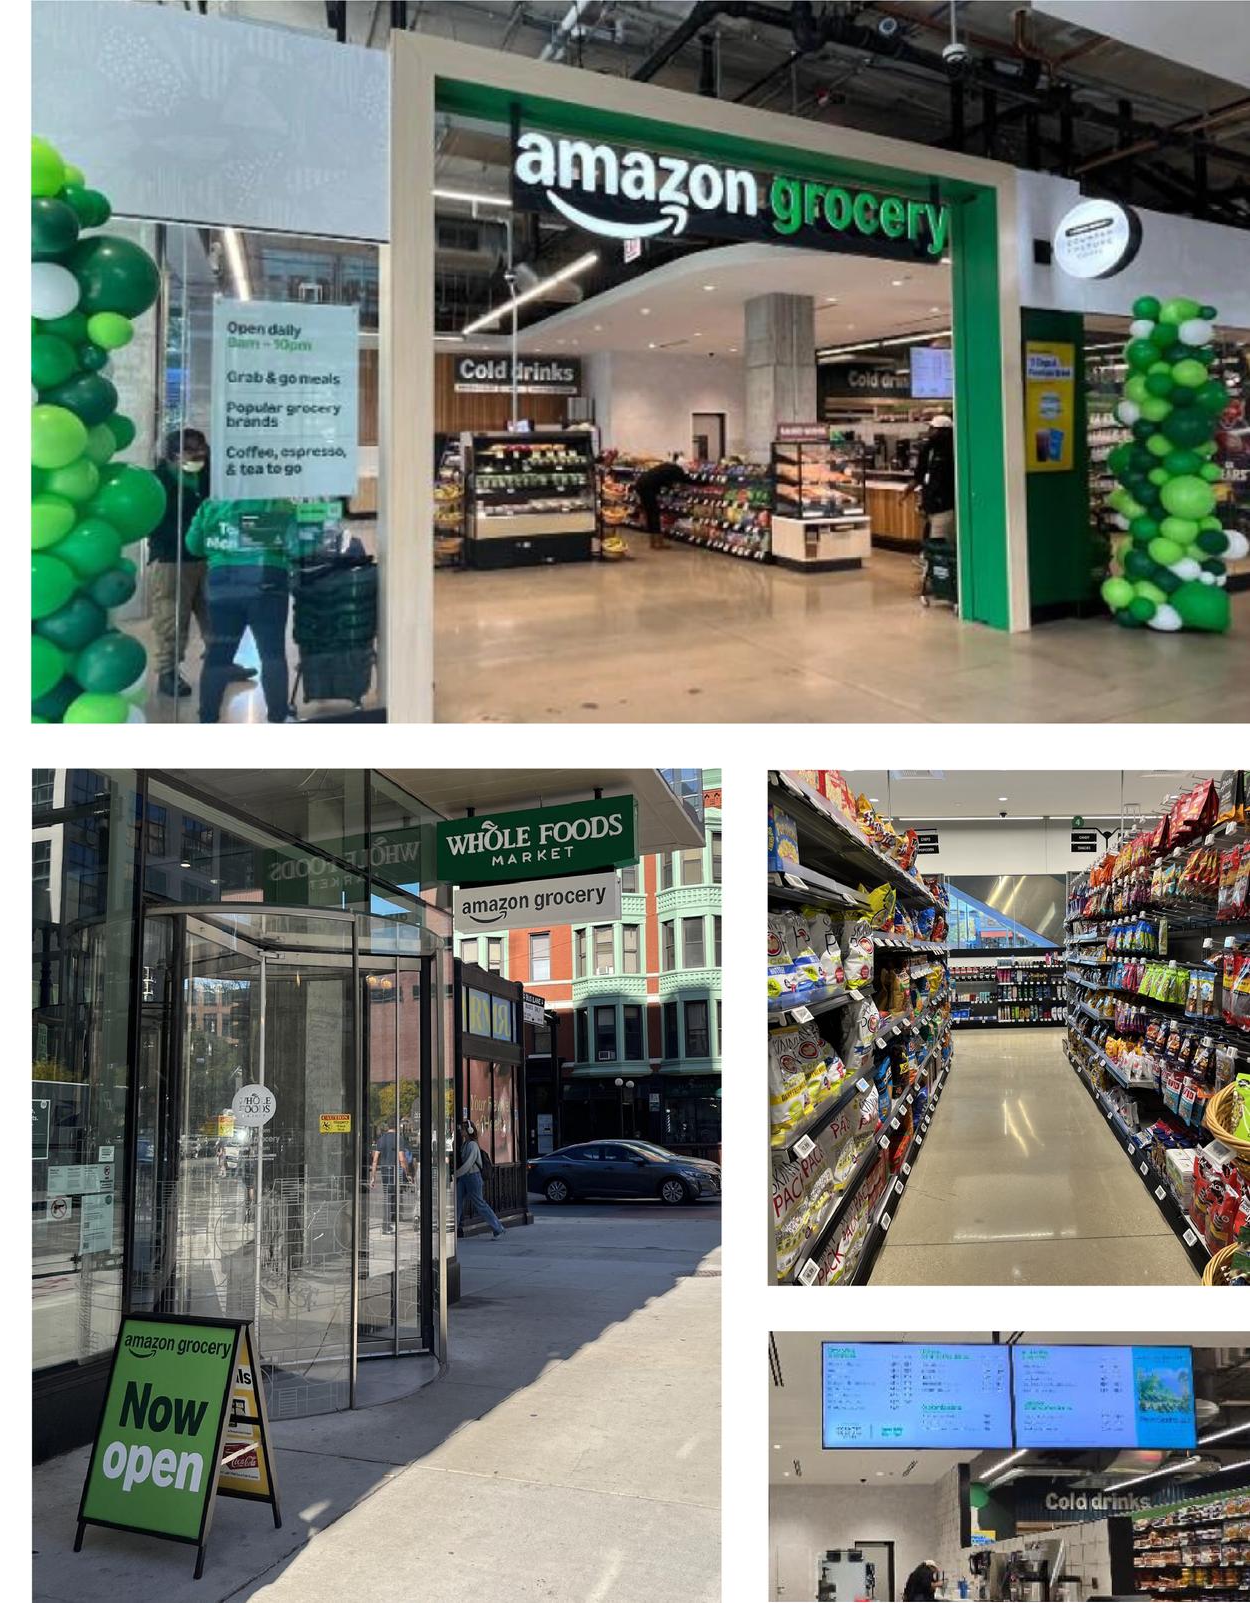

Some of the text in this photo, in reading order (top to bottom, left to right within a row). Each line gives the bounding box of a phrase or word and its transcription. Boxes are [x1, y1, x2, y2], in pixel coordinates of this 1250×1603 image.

[515, 132, 950, 255] amazon grocery
[227, 321, 302, 340] Open daily
[273, 339, 313, 352] 10pm
[226, 370, 341, 388] Grab & go meals
[460, 359, 507, 380] Cold
[848, 371, 878, 387] Cold
[226, 401, 342, 417] Popular grocery
[226, 416, 279, 428] brands
[226, 446, 347, 460] Coffee, espresso,
[226, 463, 302, 476] & tea to go
[446, 813, 623, 856] WHOLE FOODS
[491, 846, 574, 866] MARKET
[462, 887, 607, 915] amazon grocery
[125, 1333, 232, 1359] amazon grocery
[118, 1380, 209, 1437] Now
[102, 1440, 204, 1493] open
[1046, 1492, 1151, 1511] Cold drinks
